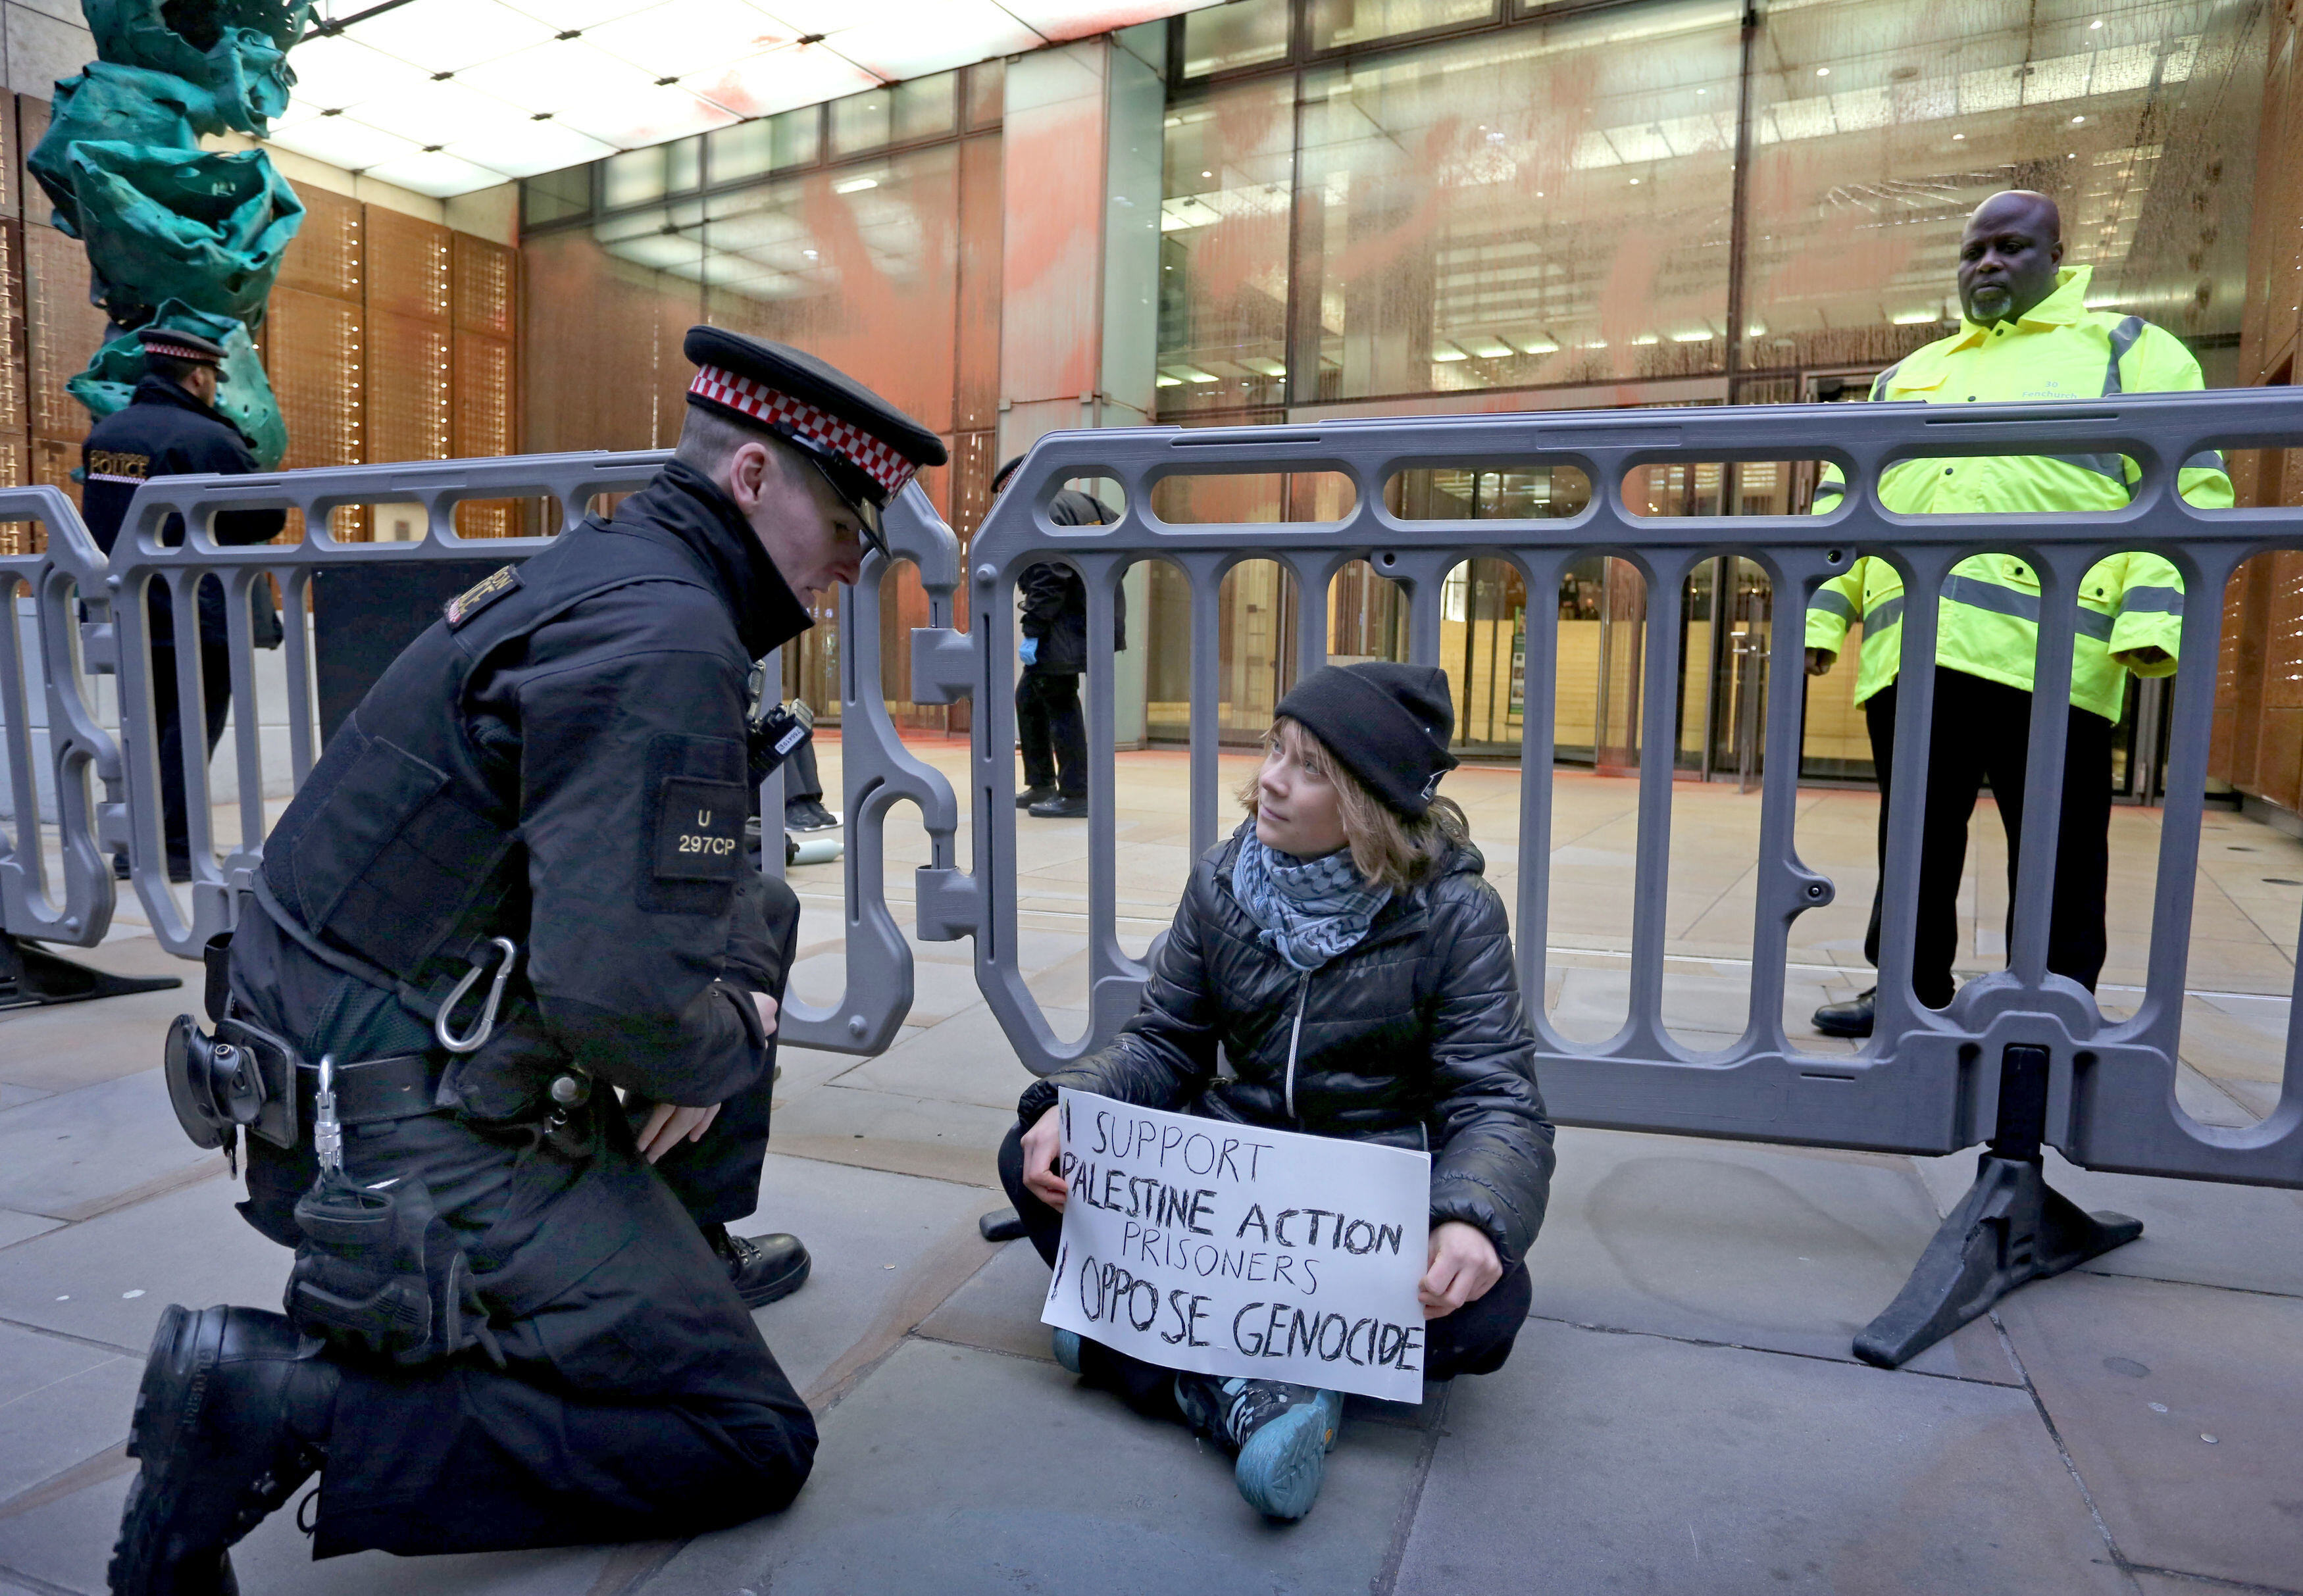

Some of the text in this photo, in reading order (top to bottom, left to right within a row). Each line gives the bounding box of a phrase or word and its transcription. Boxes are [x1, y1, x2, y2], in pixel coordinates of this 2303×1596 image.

[90, 458, 147, 478] POLICE
[678, 835, 736, 855] 297CP
[698, 809, 711, 827] U
[1092, 1110, 1274, 1182] SUPPORT
[1061, 1151, 1402, 1256] PALESTINE ACTION
[1123, 1221, 1320, 1295] PRISONERS
[1080, 1255, 1213, 1347] OPPOSE
[1233, 1302, 1425, 1372] GENOCIDE
